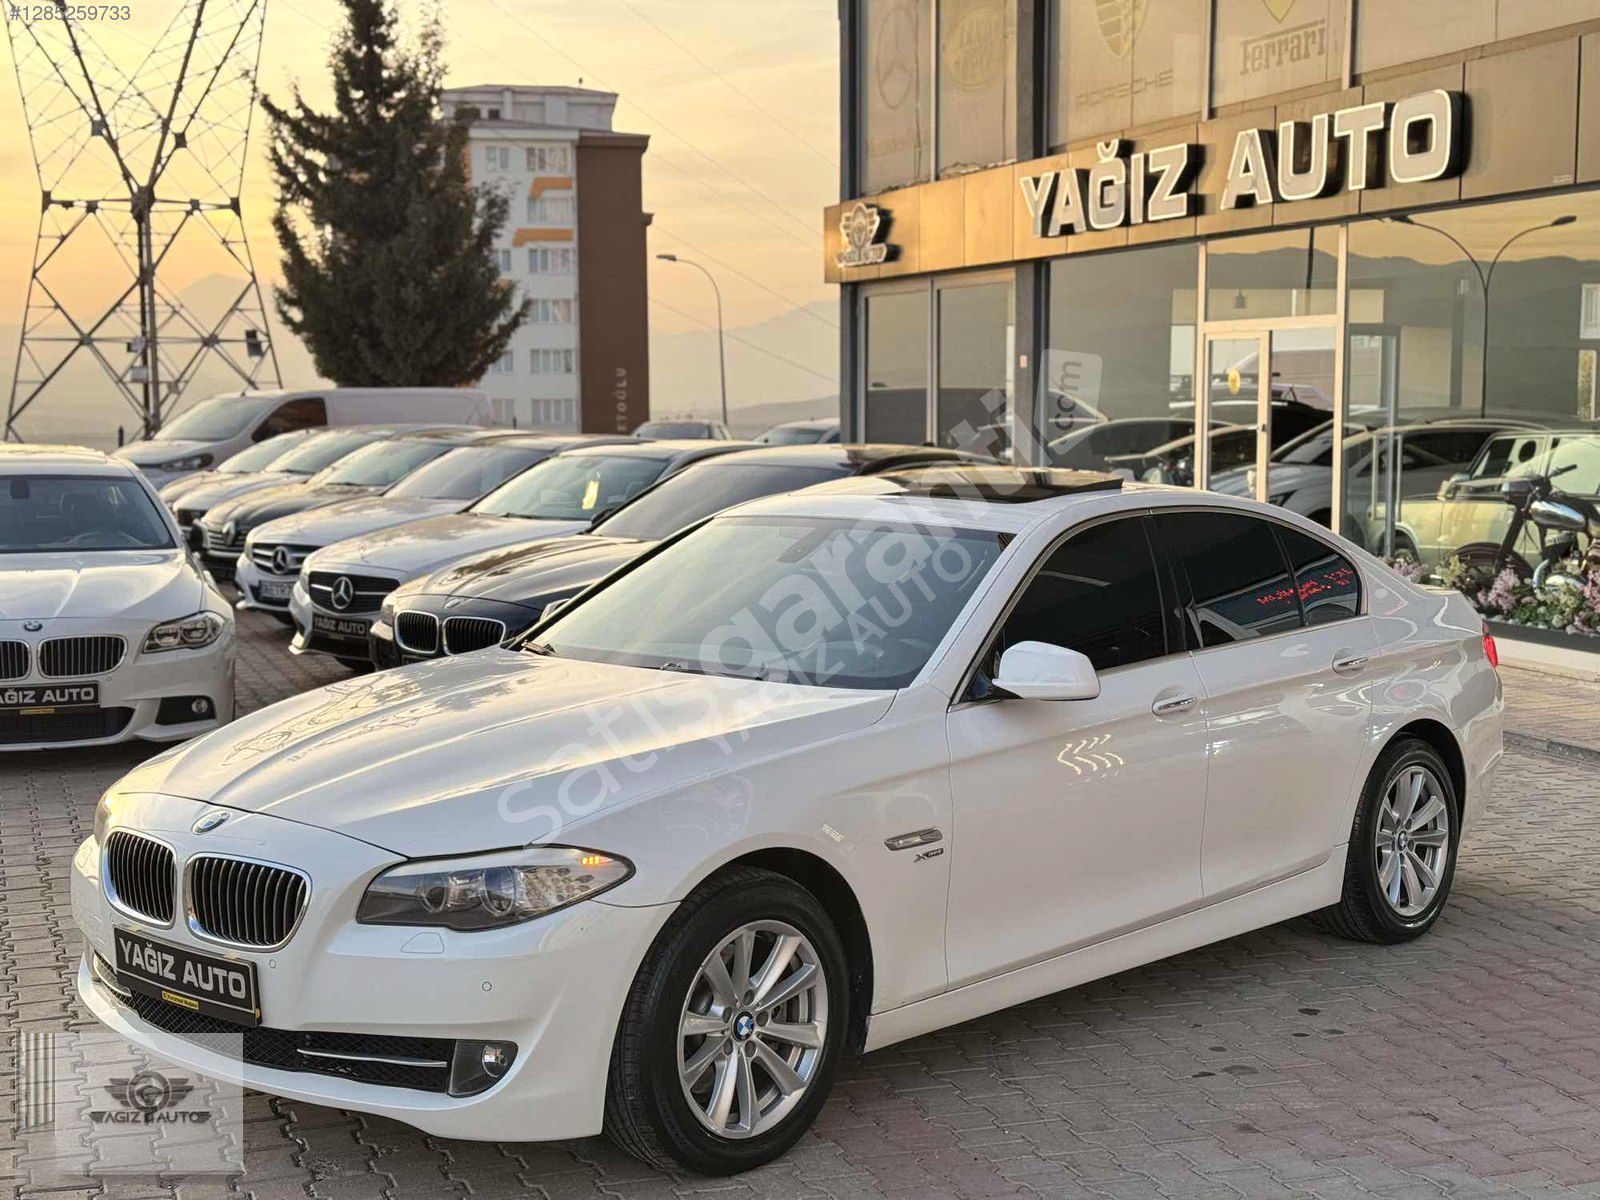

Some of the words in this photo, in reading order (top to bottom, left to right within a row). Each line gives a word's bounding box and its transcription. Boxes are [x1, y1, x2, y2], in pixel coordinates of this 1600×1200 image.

[1240, 19, 1326, 75] Ferrari
[1019, 138, 1188, 238] YAĞIZ
[1220, 89, 1452, 210] AUTO
[338, 620, 366, 635] AUTO
[41, 687, 95, 703] AUTO
[119, 938, 177, 981] YAĞIZ
[182, 960, 246, 999] AUTO
